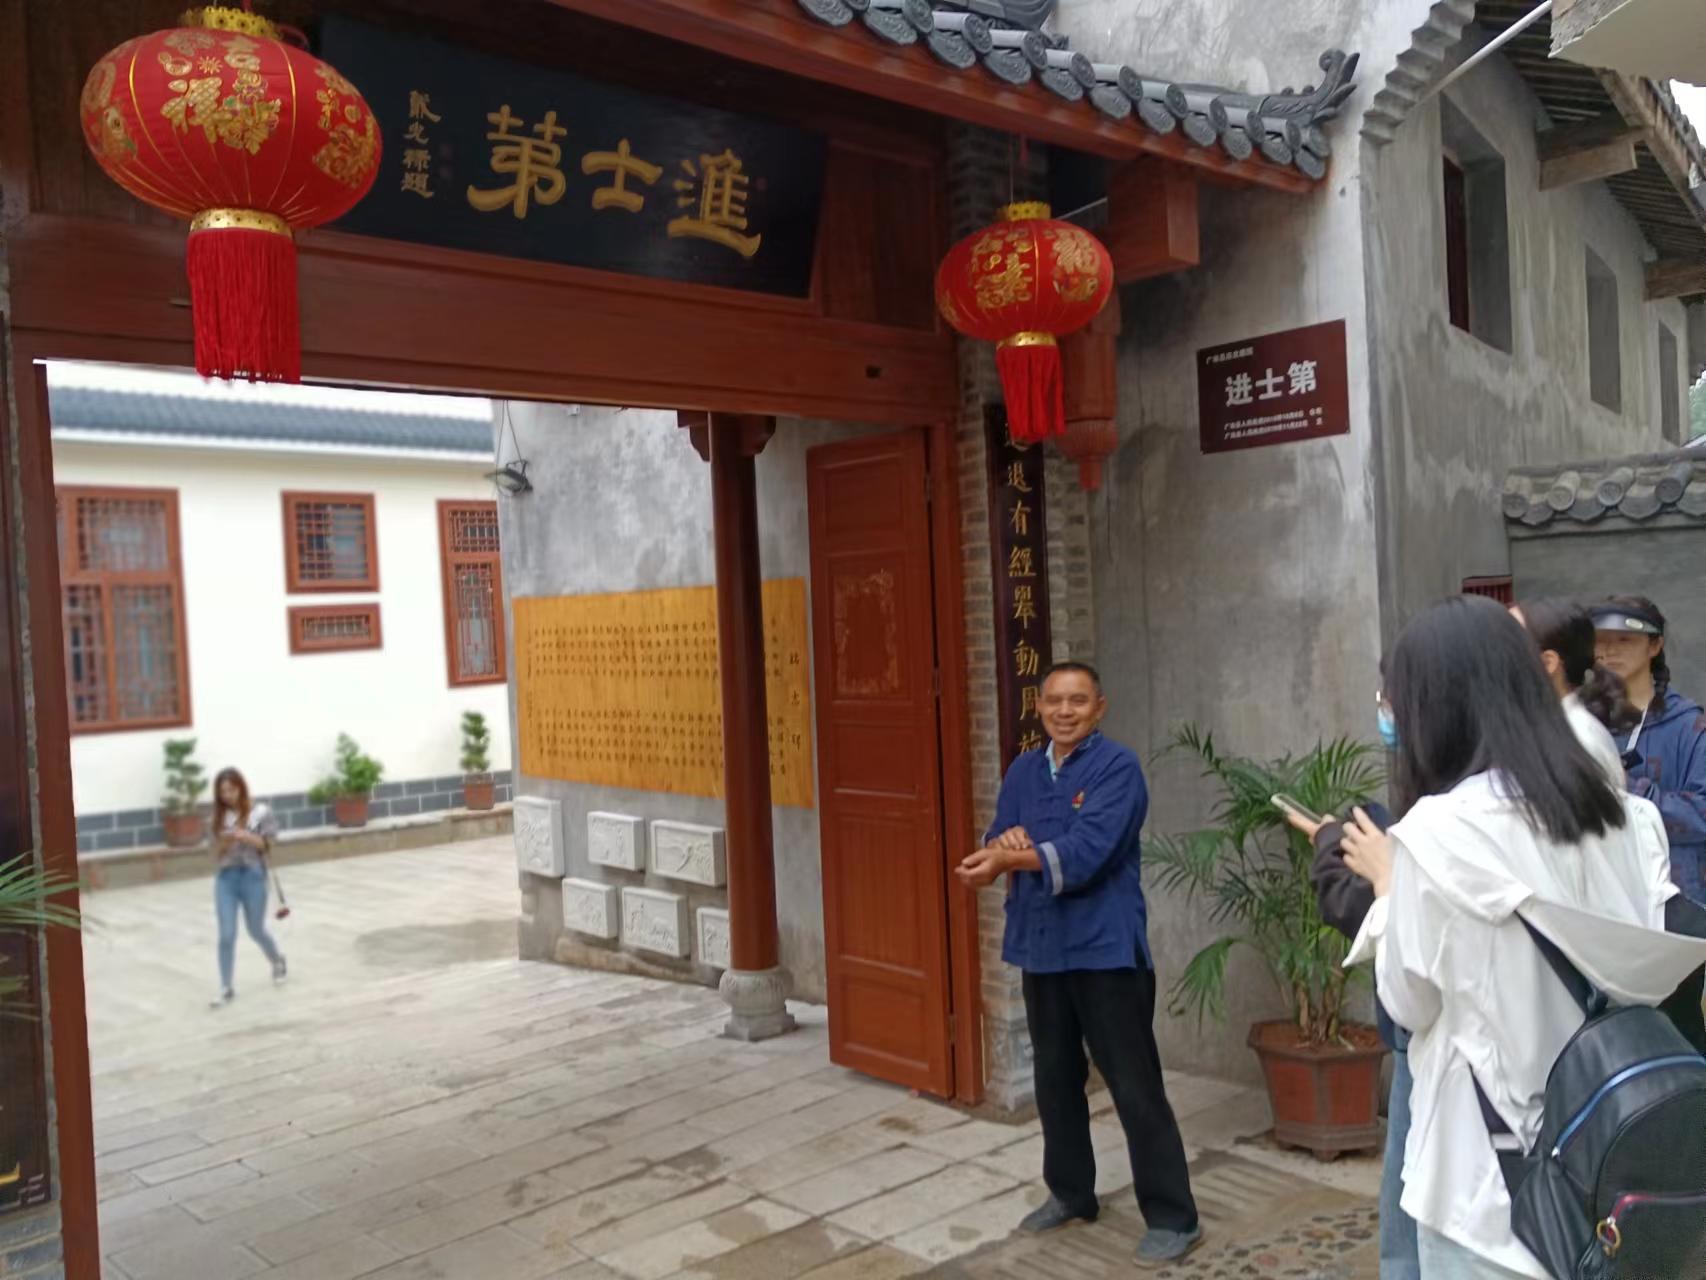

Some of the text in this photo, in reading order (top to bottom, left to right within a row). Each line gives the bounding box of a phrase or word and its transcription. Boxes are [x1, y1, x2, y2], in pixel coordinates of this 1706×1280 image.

[1225, 360, 1317, 407] 进士第
[1004, 423, 1042, 755] 退有經舉動周
